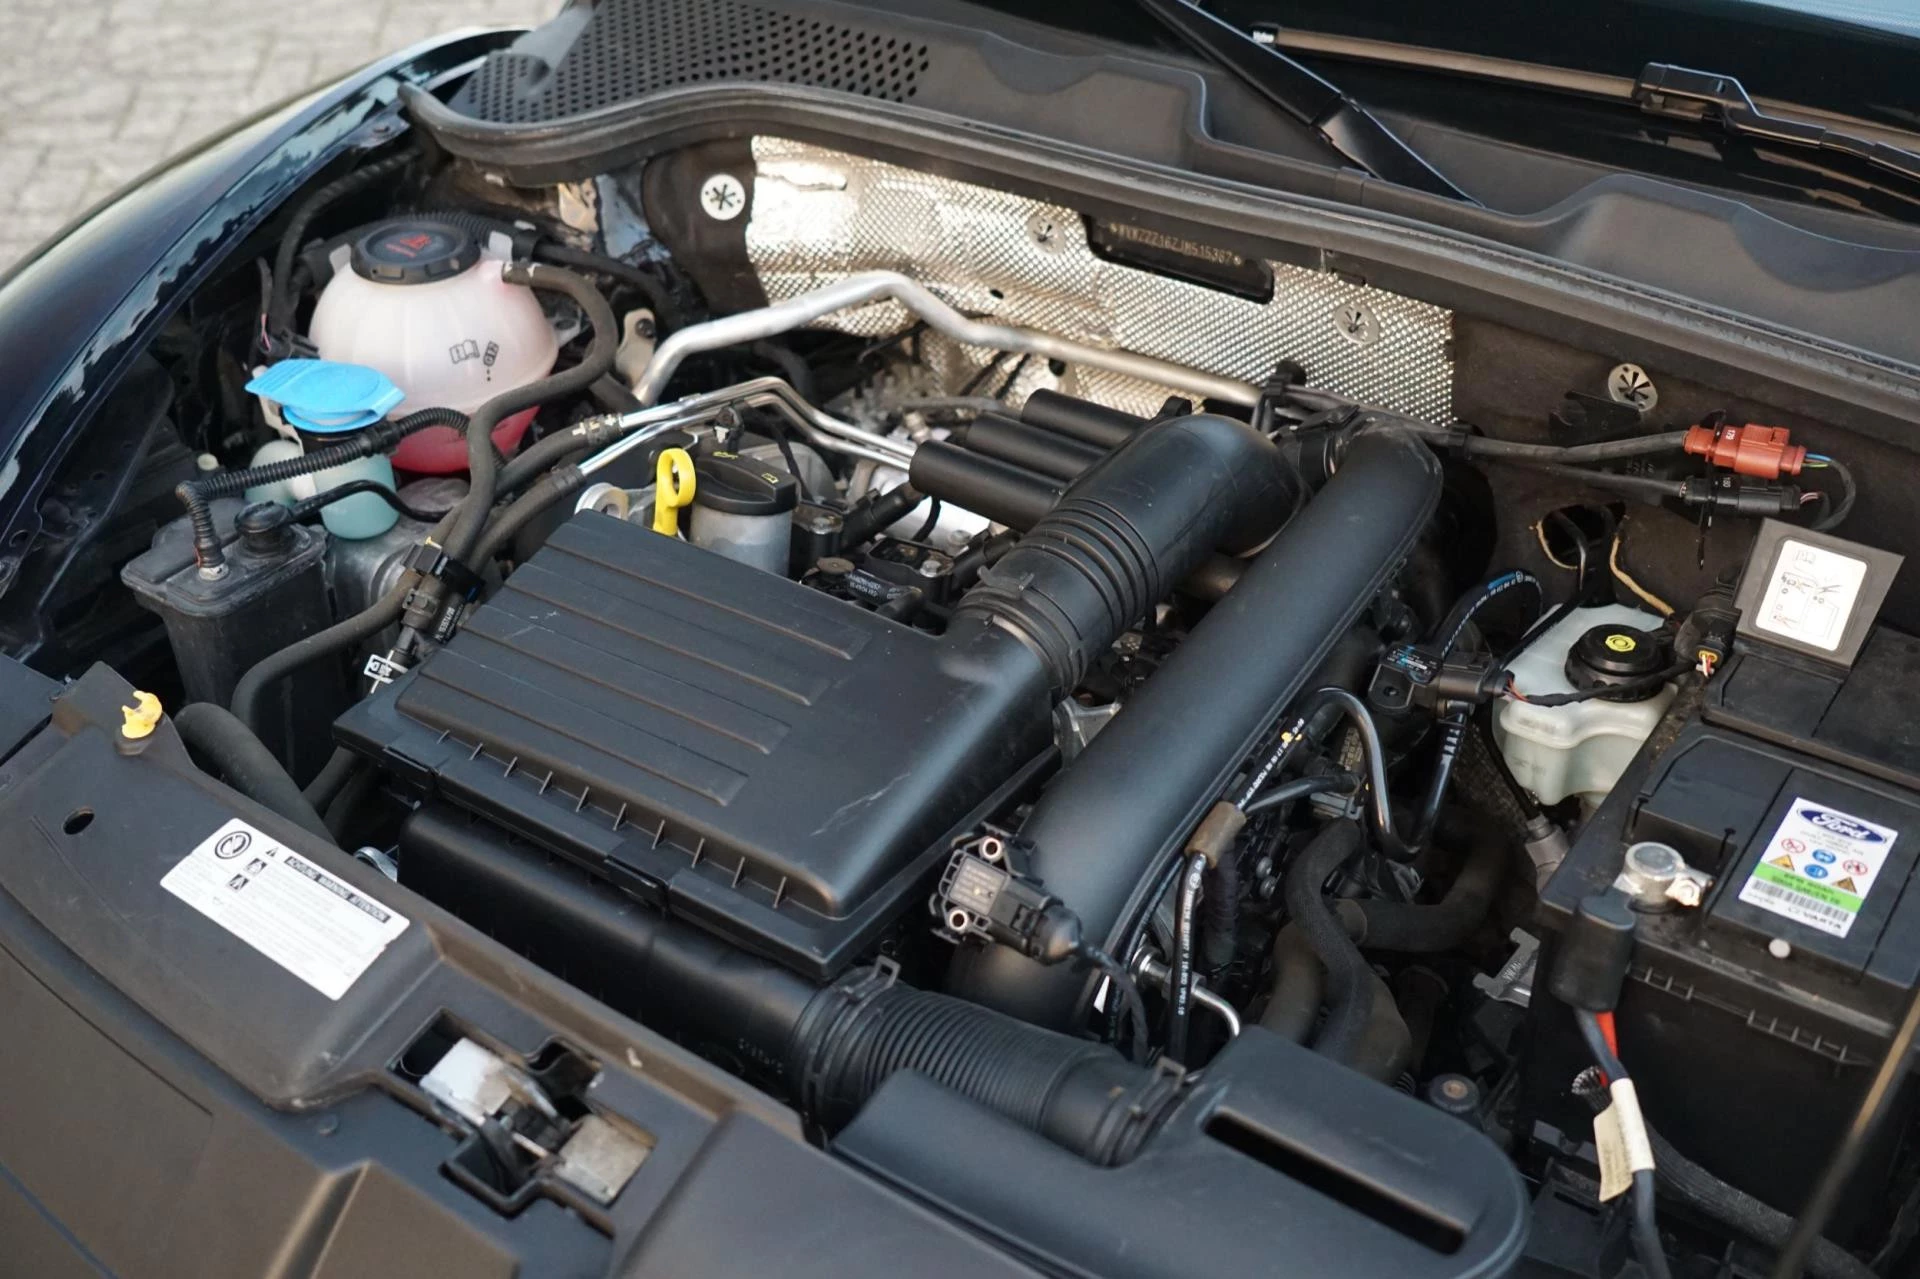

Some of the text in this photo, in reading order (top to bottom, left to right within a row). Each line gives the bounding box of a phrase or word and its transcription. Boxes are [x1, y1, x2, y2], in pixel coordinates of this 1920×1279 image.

[1811, 812, 1872, 840] Ford
[287, 857, 389, 922] ACHTUNG WARNING ATTENTION
